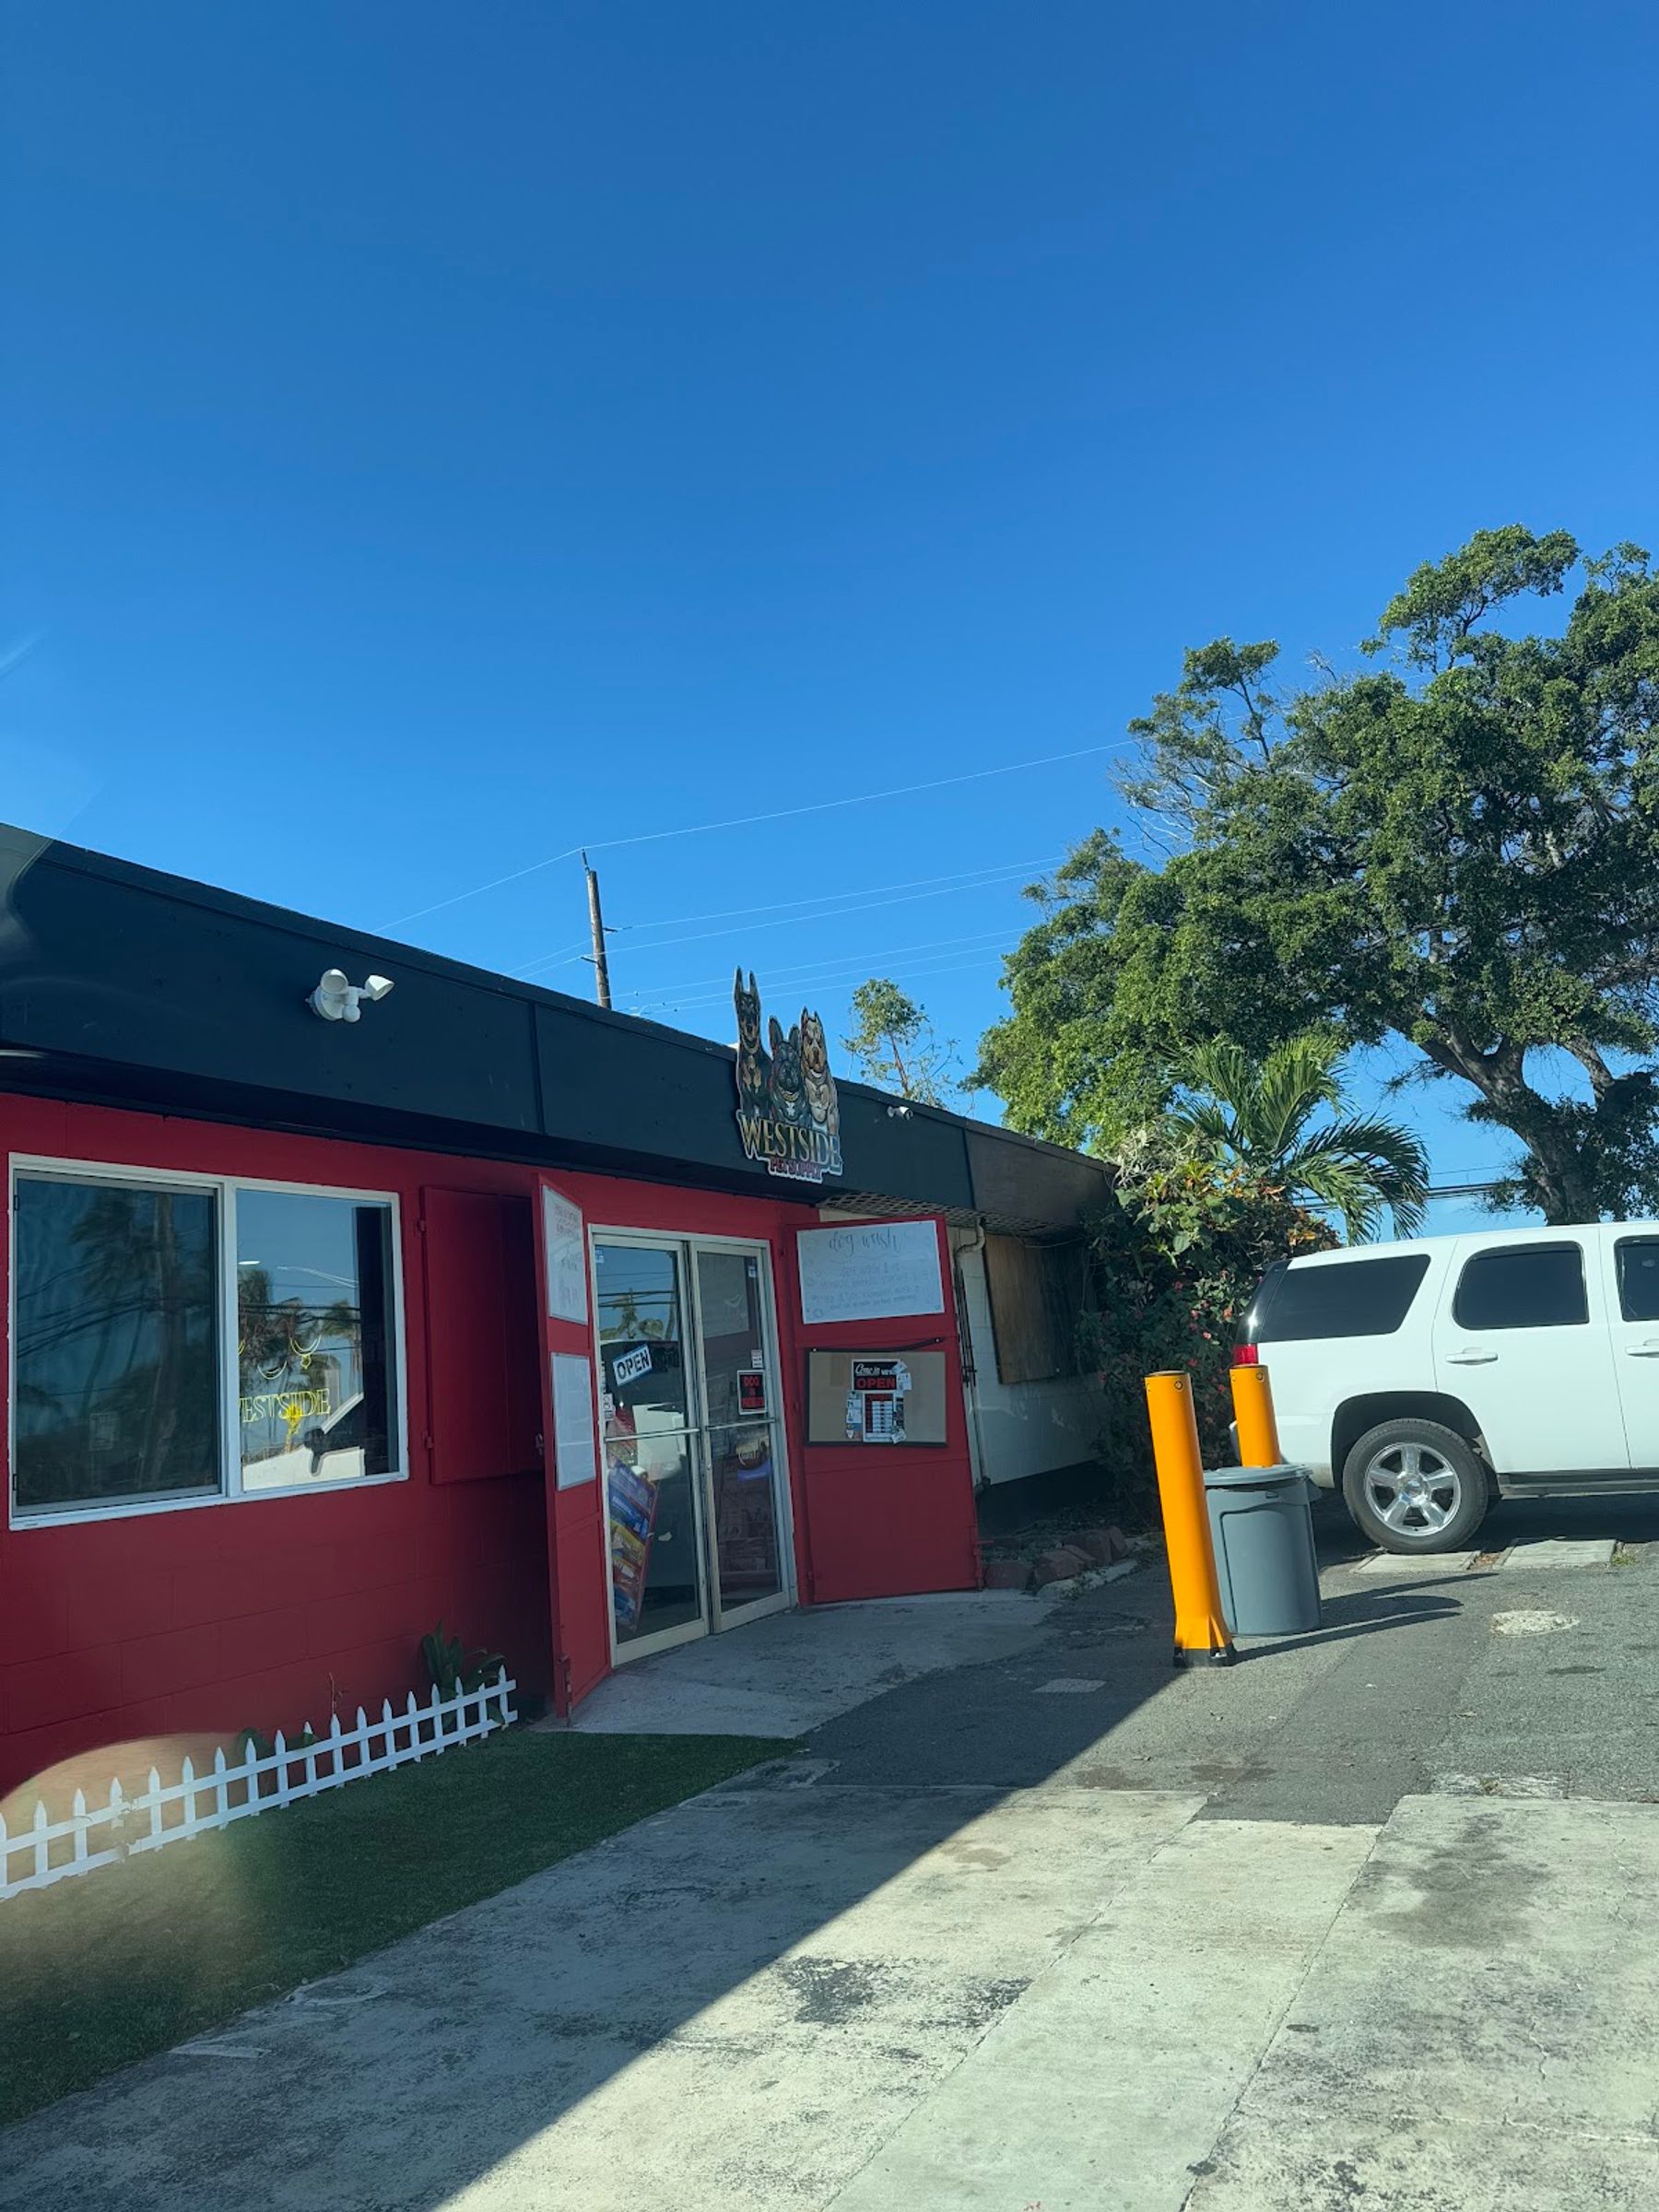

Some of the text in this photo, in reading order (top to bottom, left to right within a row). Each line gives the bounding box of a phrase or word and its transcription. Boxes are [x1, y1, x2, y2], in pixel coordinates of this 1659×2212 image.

[740, 1114, 842, 1168] WESTSIDE
[829, 1231, 854, 1257] dog
[617, 1348, 650, 1380] OPEN
[856, 1377, 895, 1389] OPEN
[240, 1388, 331, 1423] ESTSIDE
